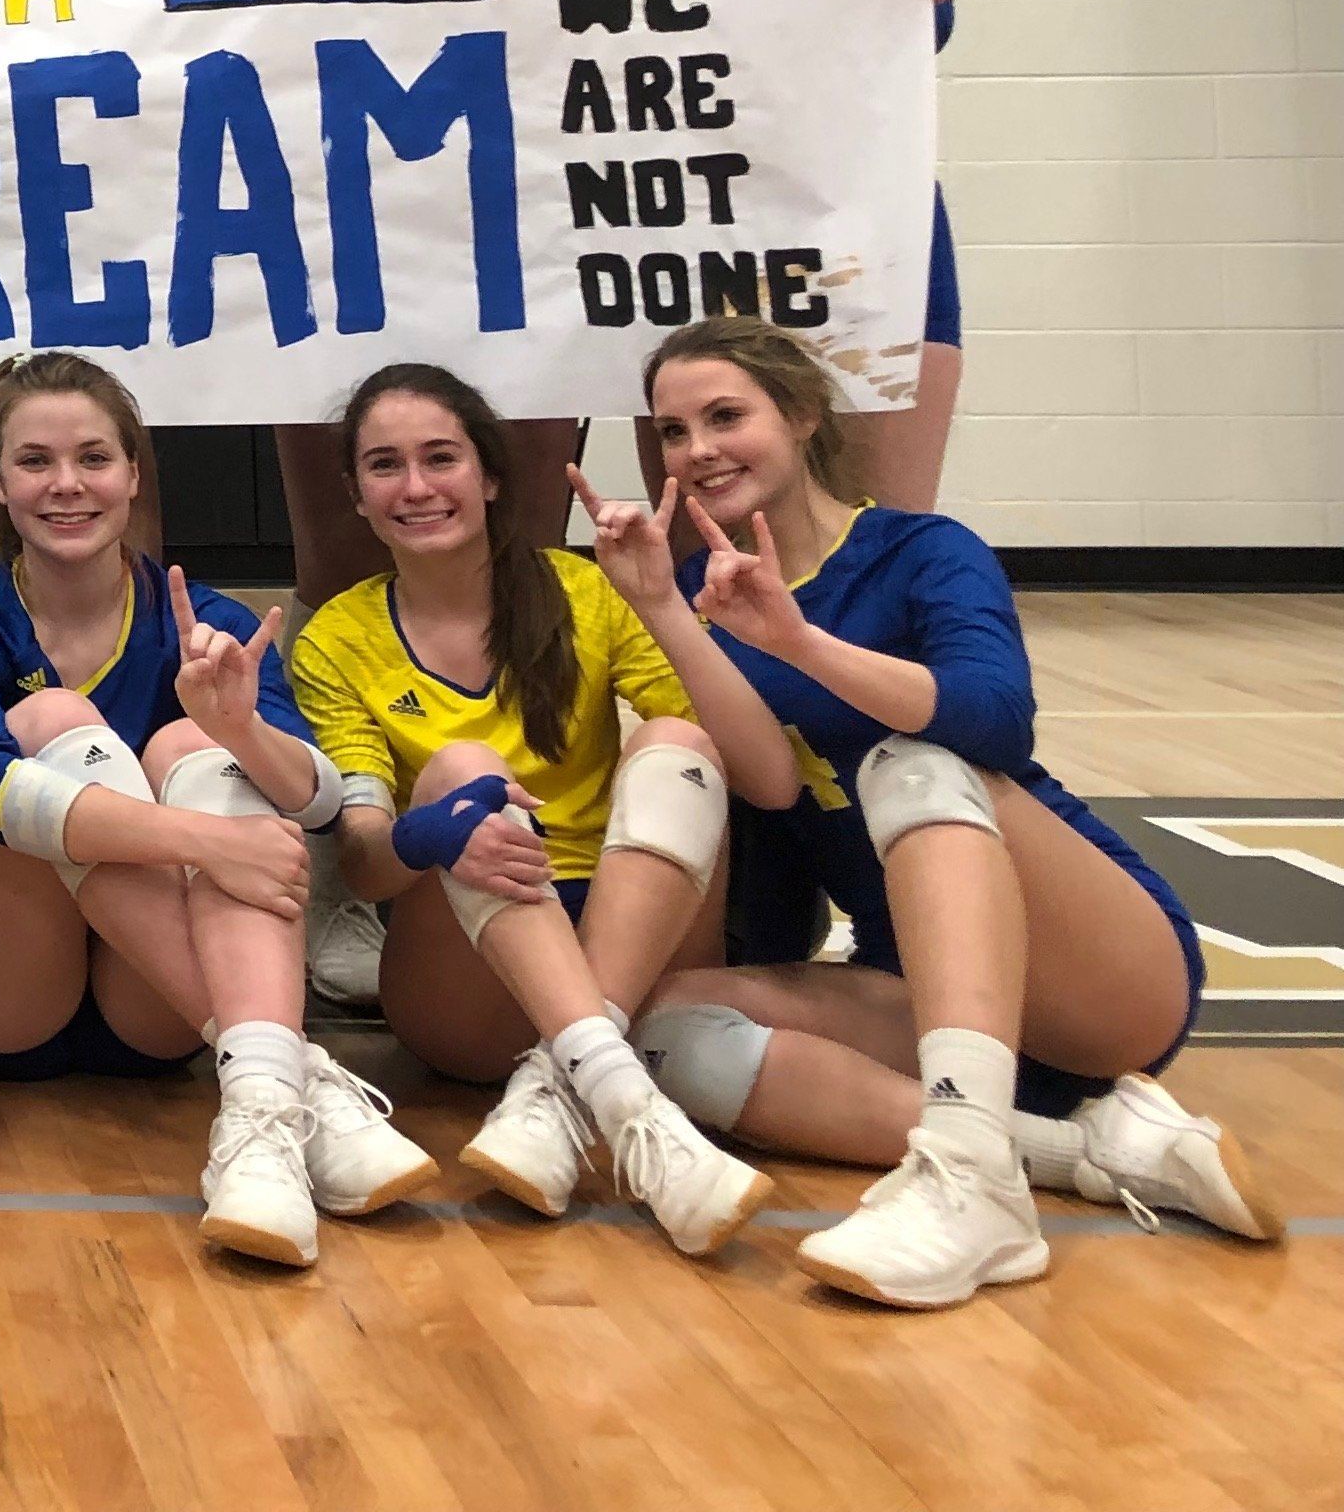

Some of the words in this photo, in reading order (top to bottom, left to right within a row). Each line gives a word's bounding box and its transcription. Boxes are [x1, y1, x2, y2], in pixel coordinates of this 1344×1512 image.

[561, 54, 735, 134] ARE
[566, 154, 750, 230] NOT
[576, 248, 829, 328] DONE
